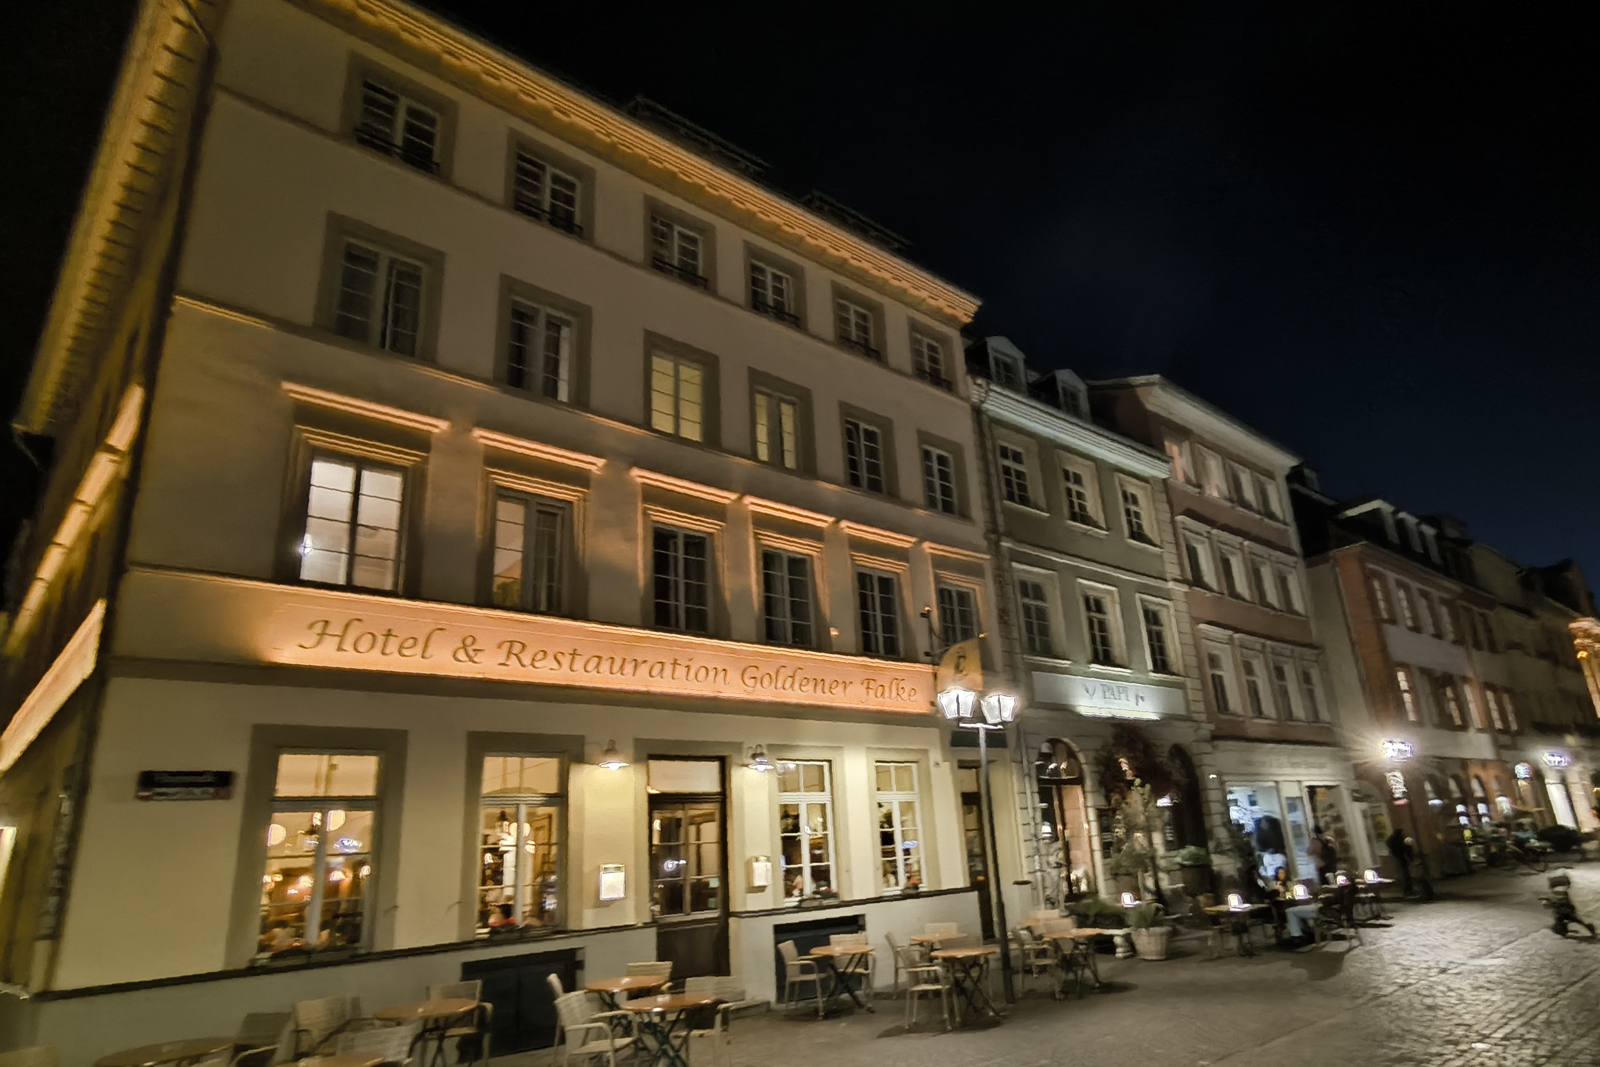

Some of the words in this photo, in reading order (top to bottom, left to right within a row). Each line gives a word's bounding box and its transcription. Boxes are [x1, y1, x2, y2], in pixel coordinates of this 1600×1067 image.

[298, 617, 447, 660] Hotel
[452, 633, 486, 665] &
[497, 639, 731, 686] Restauration
[740, 664, 854, 697] Goldener
[859, 677, 918, 704] Falke
